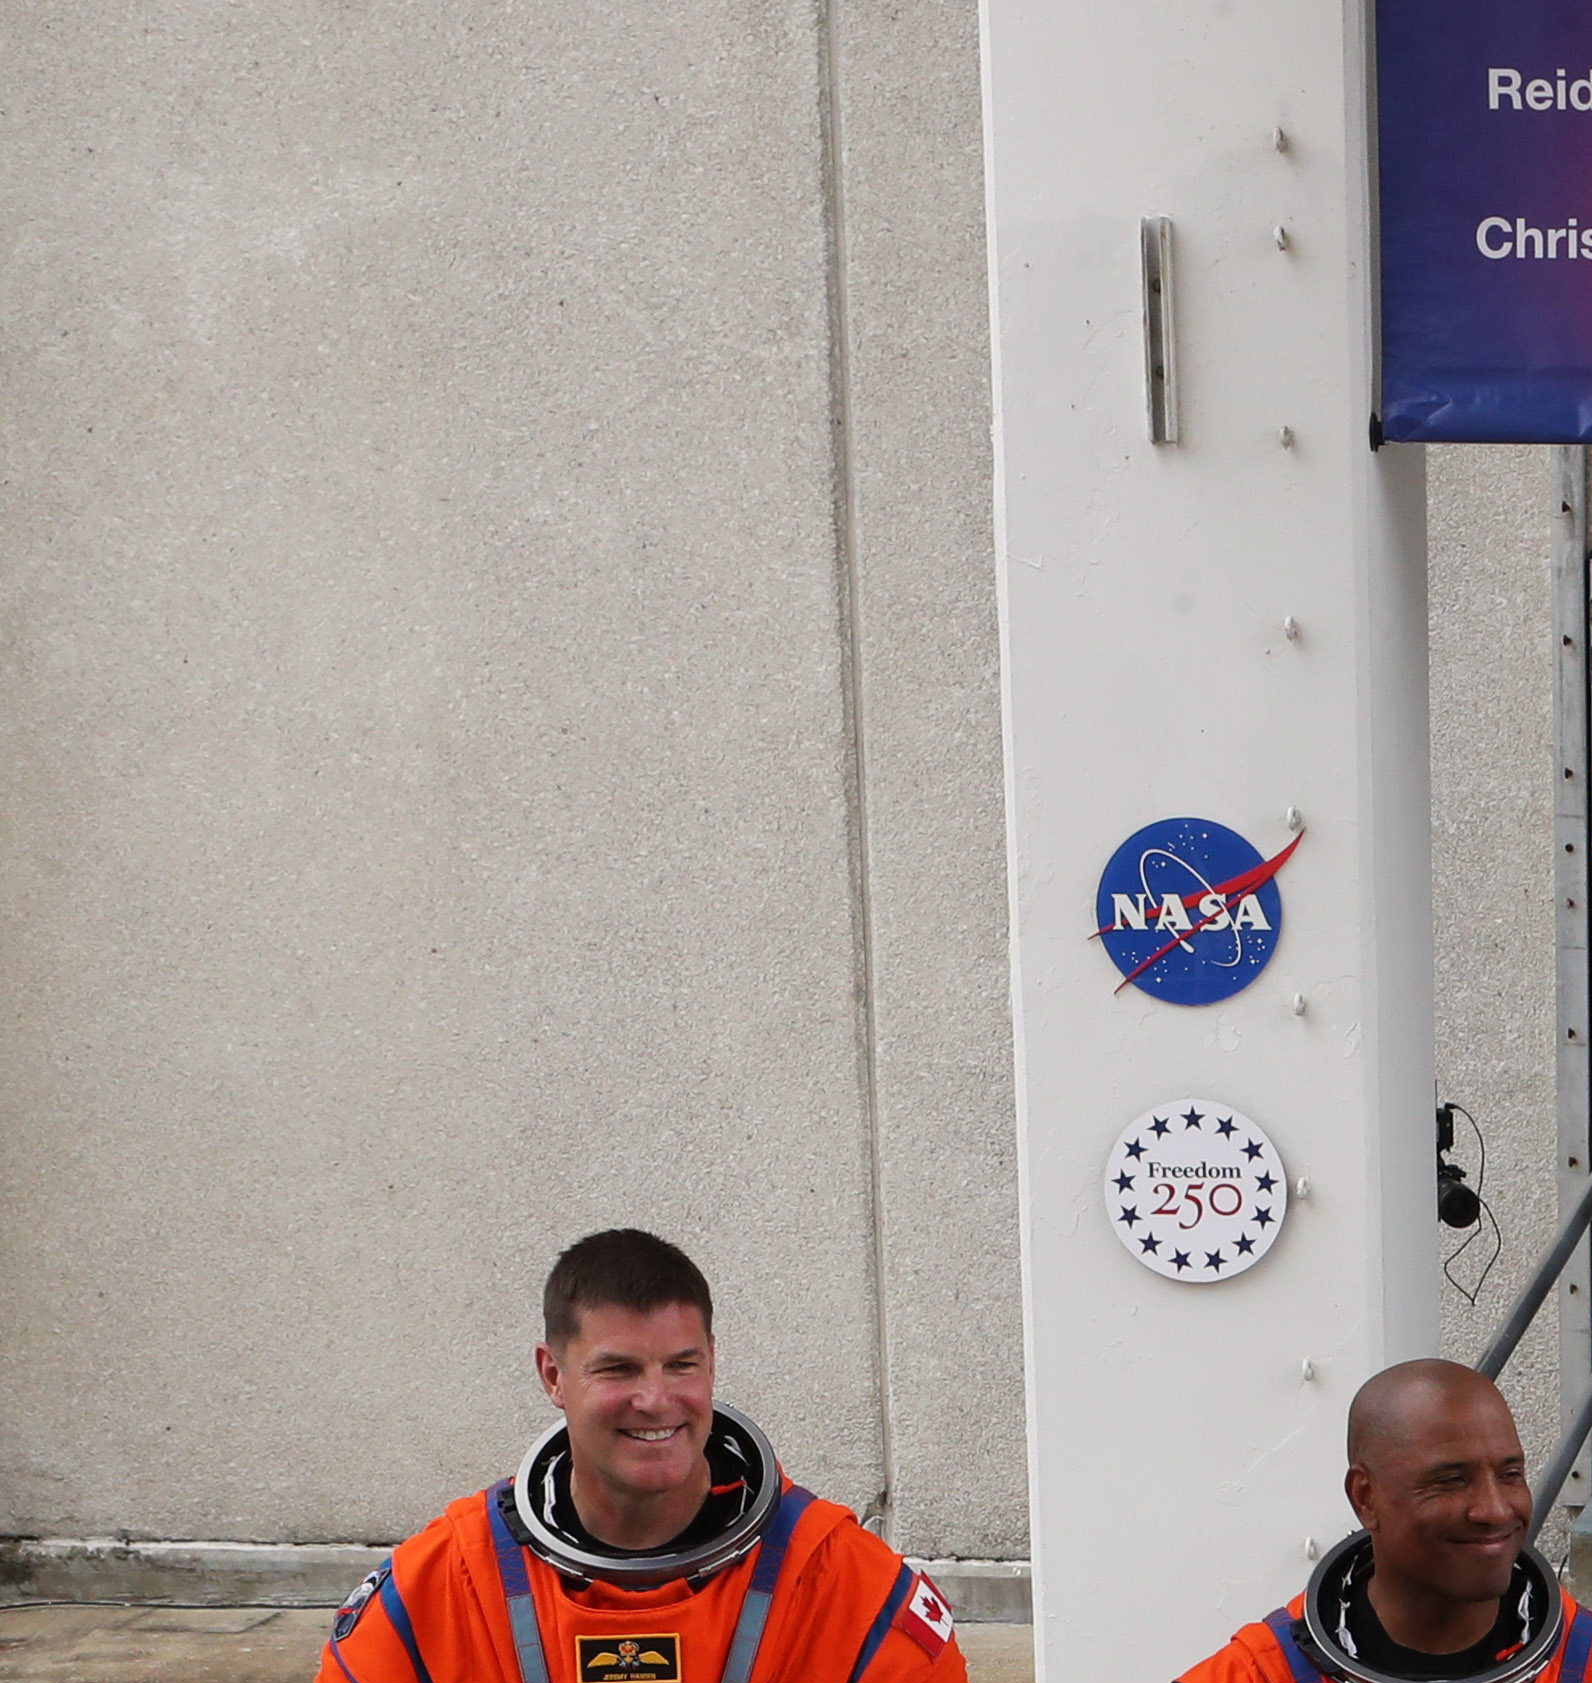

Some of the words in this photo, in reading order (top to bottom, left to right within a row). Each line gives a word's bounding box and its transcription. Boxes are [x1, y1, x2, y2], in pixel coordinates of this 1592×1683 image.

[1111, 893, 1273, 931] NASA
[1147, 1161, 1243, 1180] Freedom
[1150, 1183, 1244, 1230] 250
